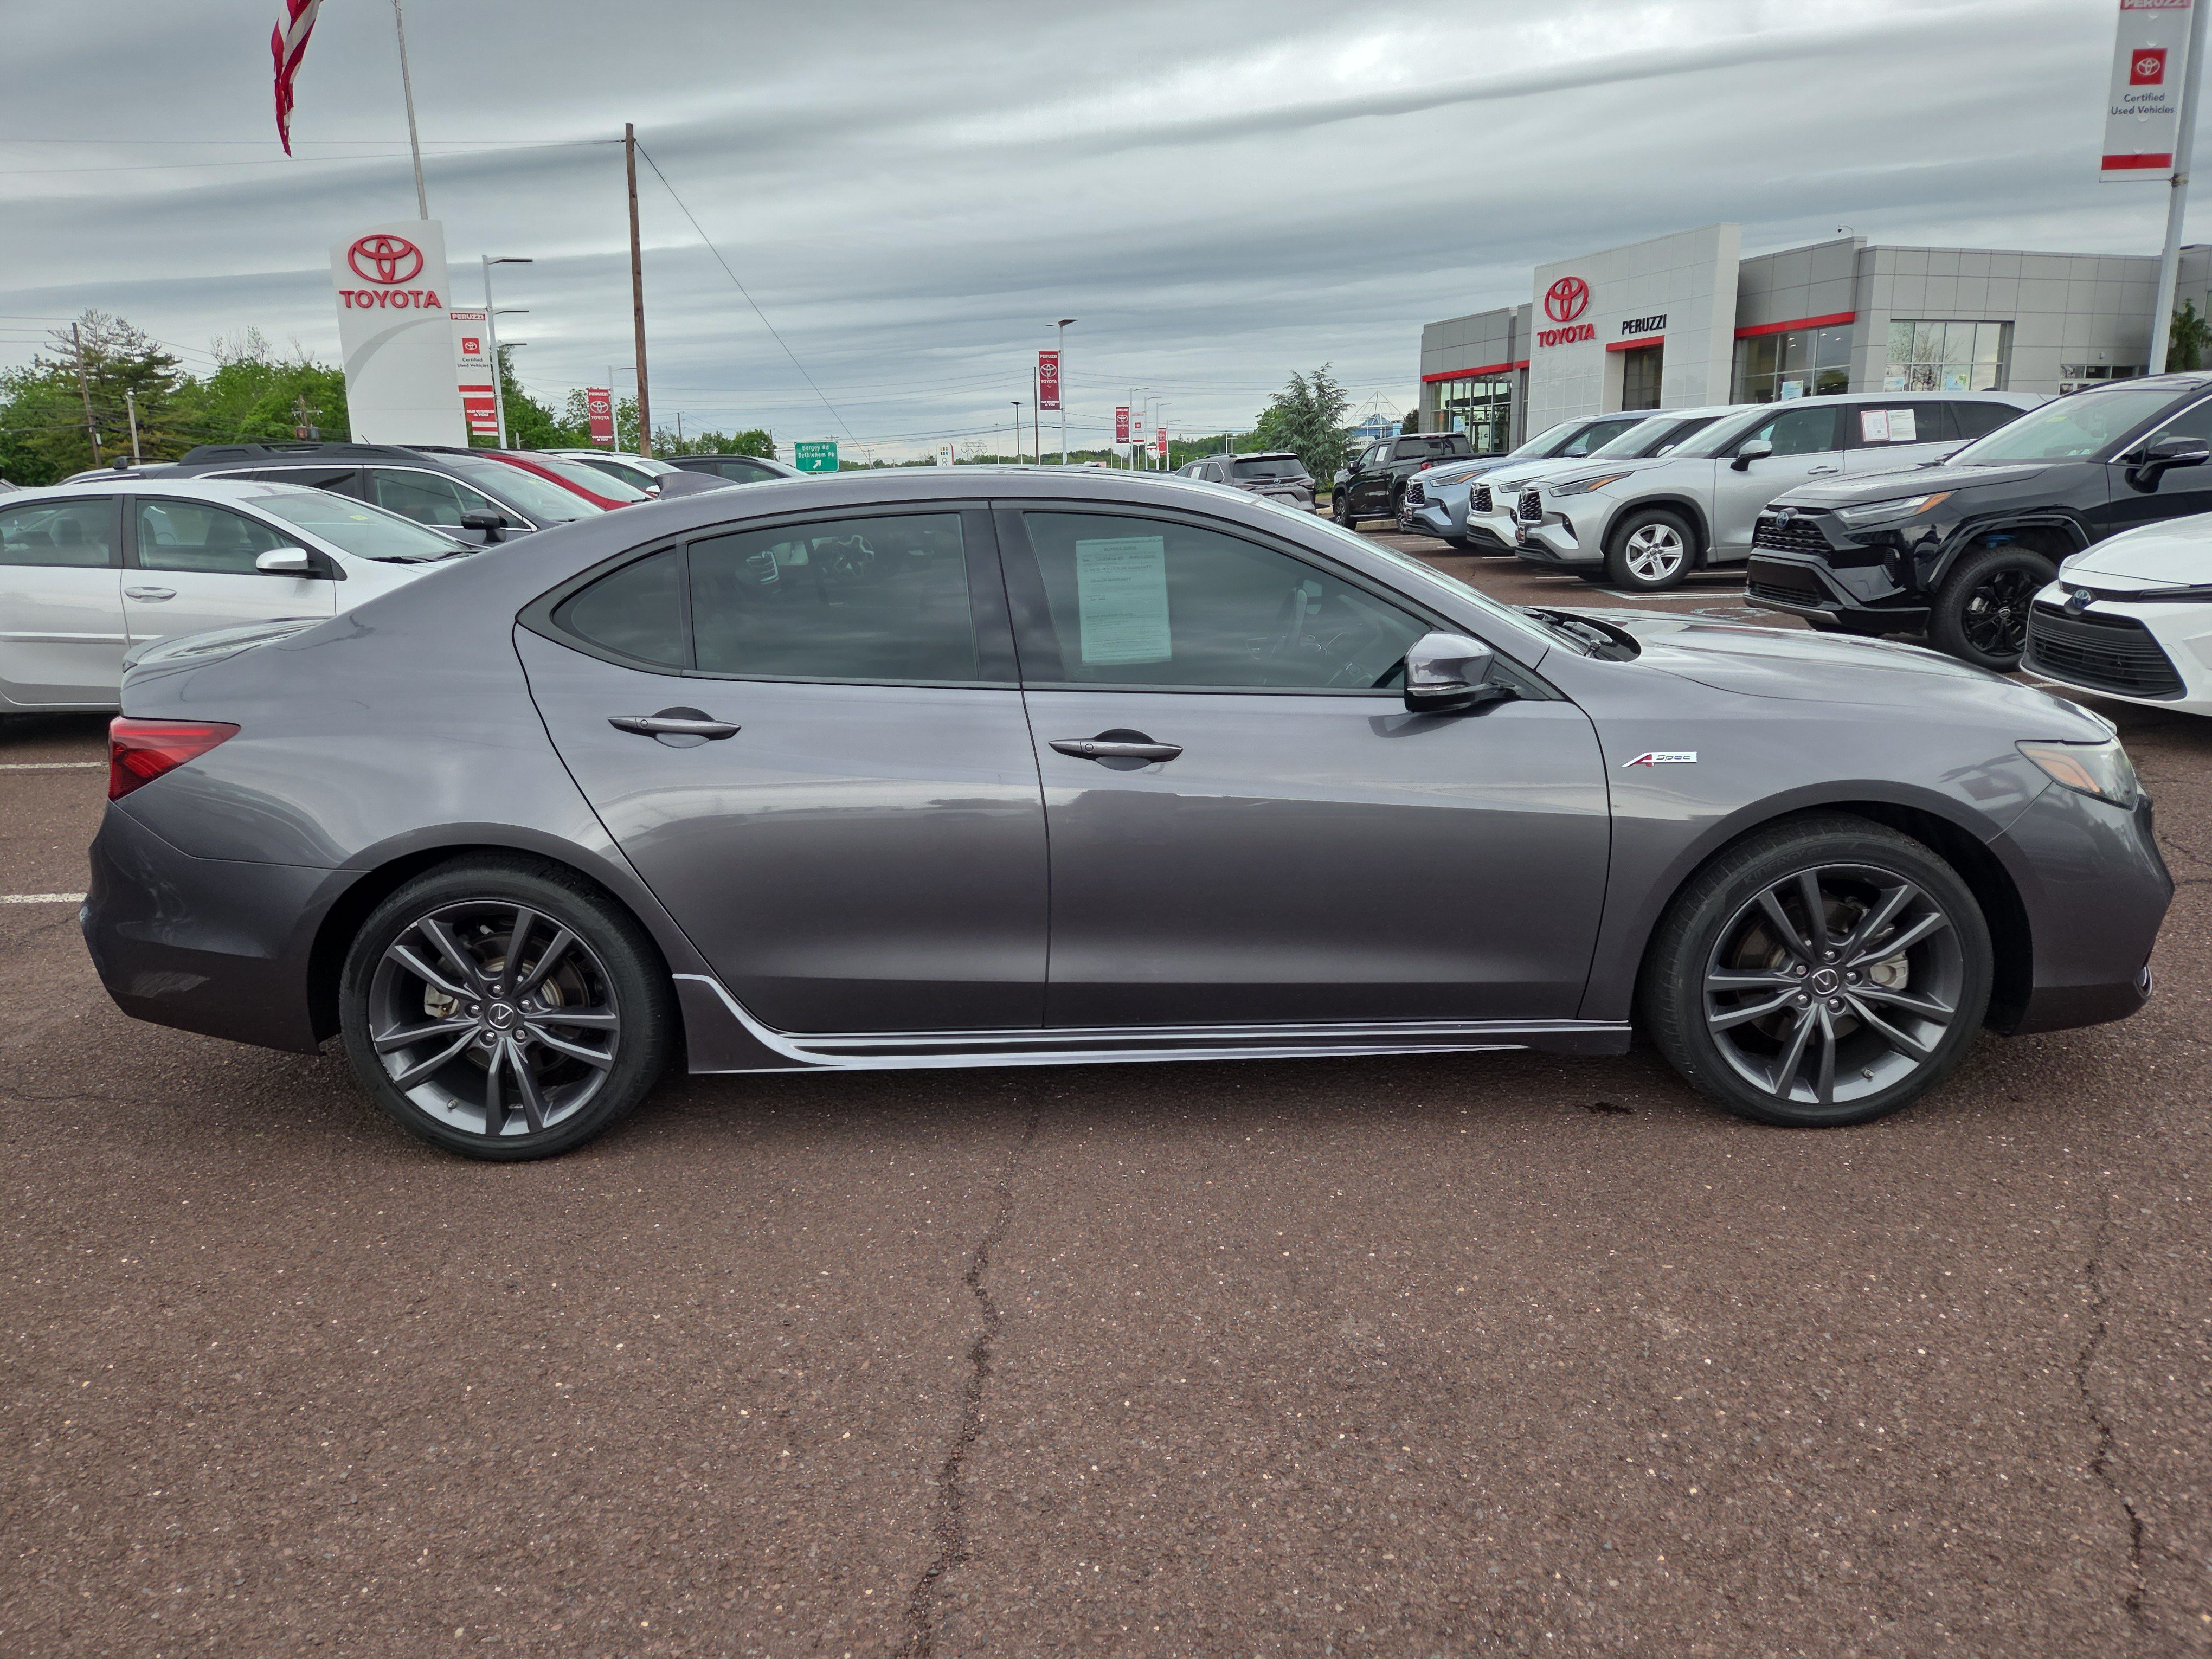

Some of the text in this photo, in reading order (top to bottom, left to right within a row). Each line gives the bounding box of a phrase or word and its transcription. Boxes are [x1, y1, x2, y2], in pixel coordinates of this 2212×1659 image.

[2124, 92, 2165, 102] Certified
[2111, 105, 2175, 115] Used Vehicles
[339, 290, 442, 308] TOYOTA
[1622, 314, 1667, 336] PERUZZI
[1537, 323, 1596, 348] TOYOTA
